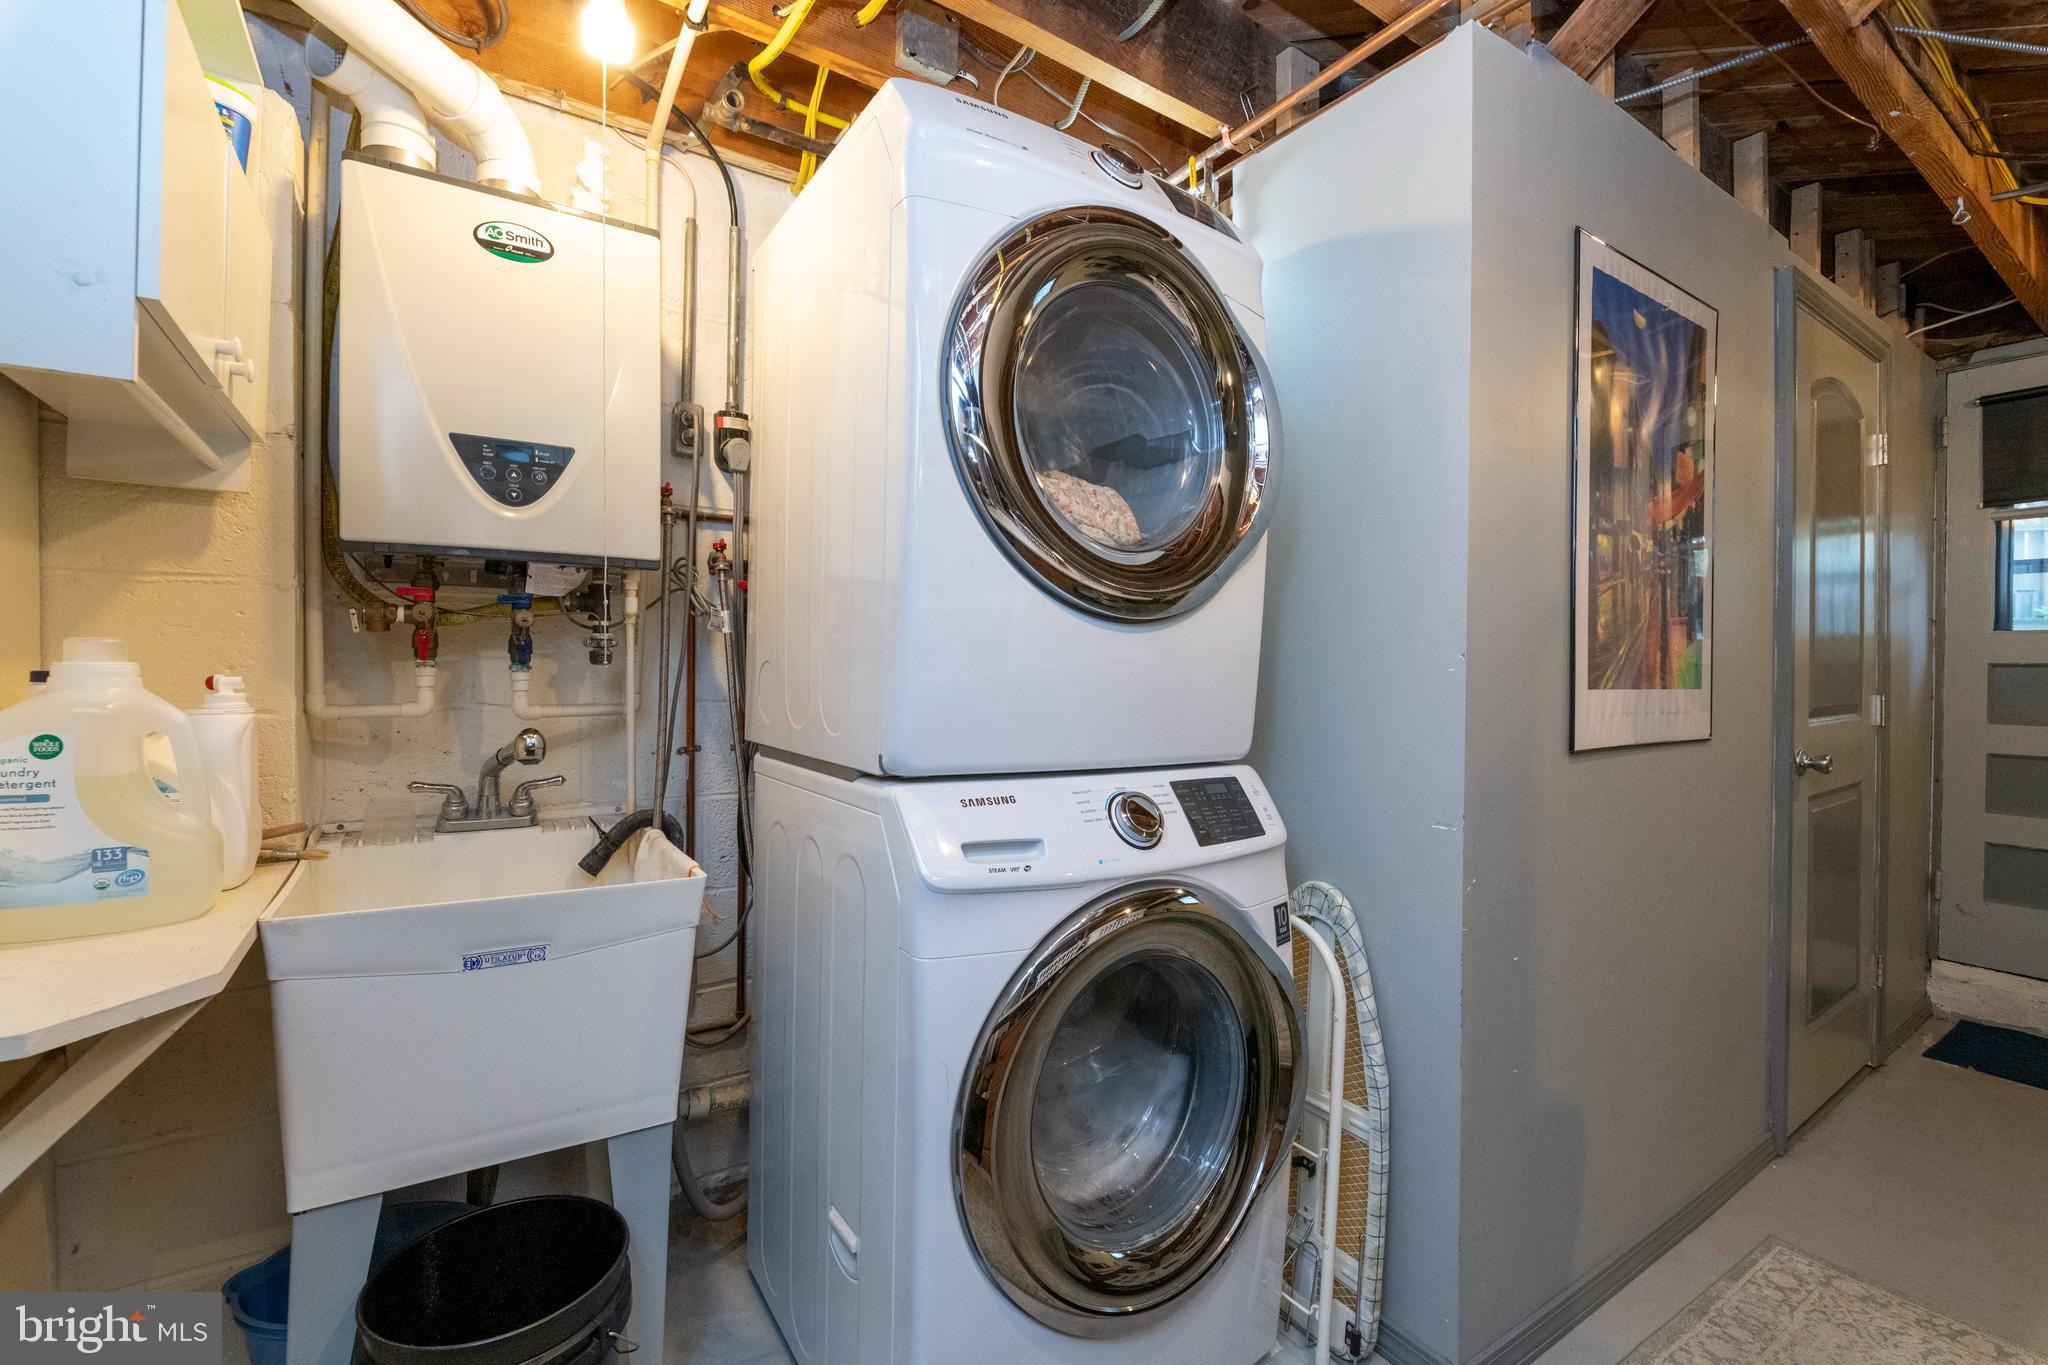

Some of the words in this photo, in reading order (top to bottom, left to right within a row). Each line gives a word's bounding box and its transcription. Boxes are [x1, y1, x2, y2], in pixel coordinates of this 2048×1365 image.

[505, 230, 544, 249] Smith
[960, 795, 1017, 808] SAMSUNG
[95, 848, 122, 861] 133
[1276, 905, 1288, 928] 10
